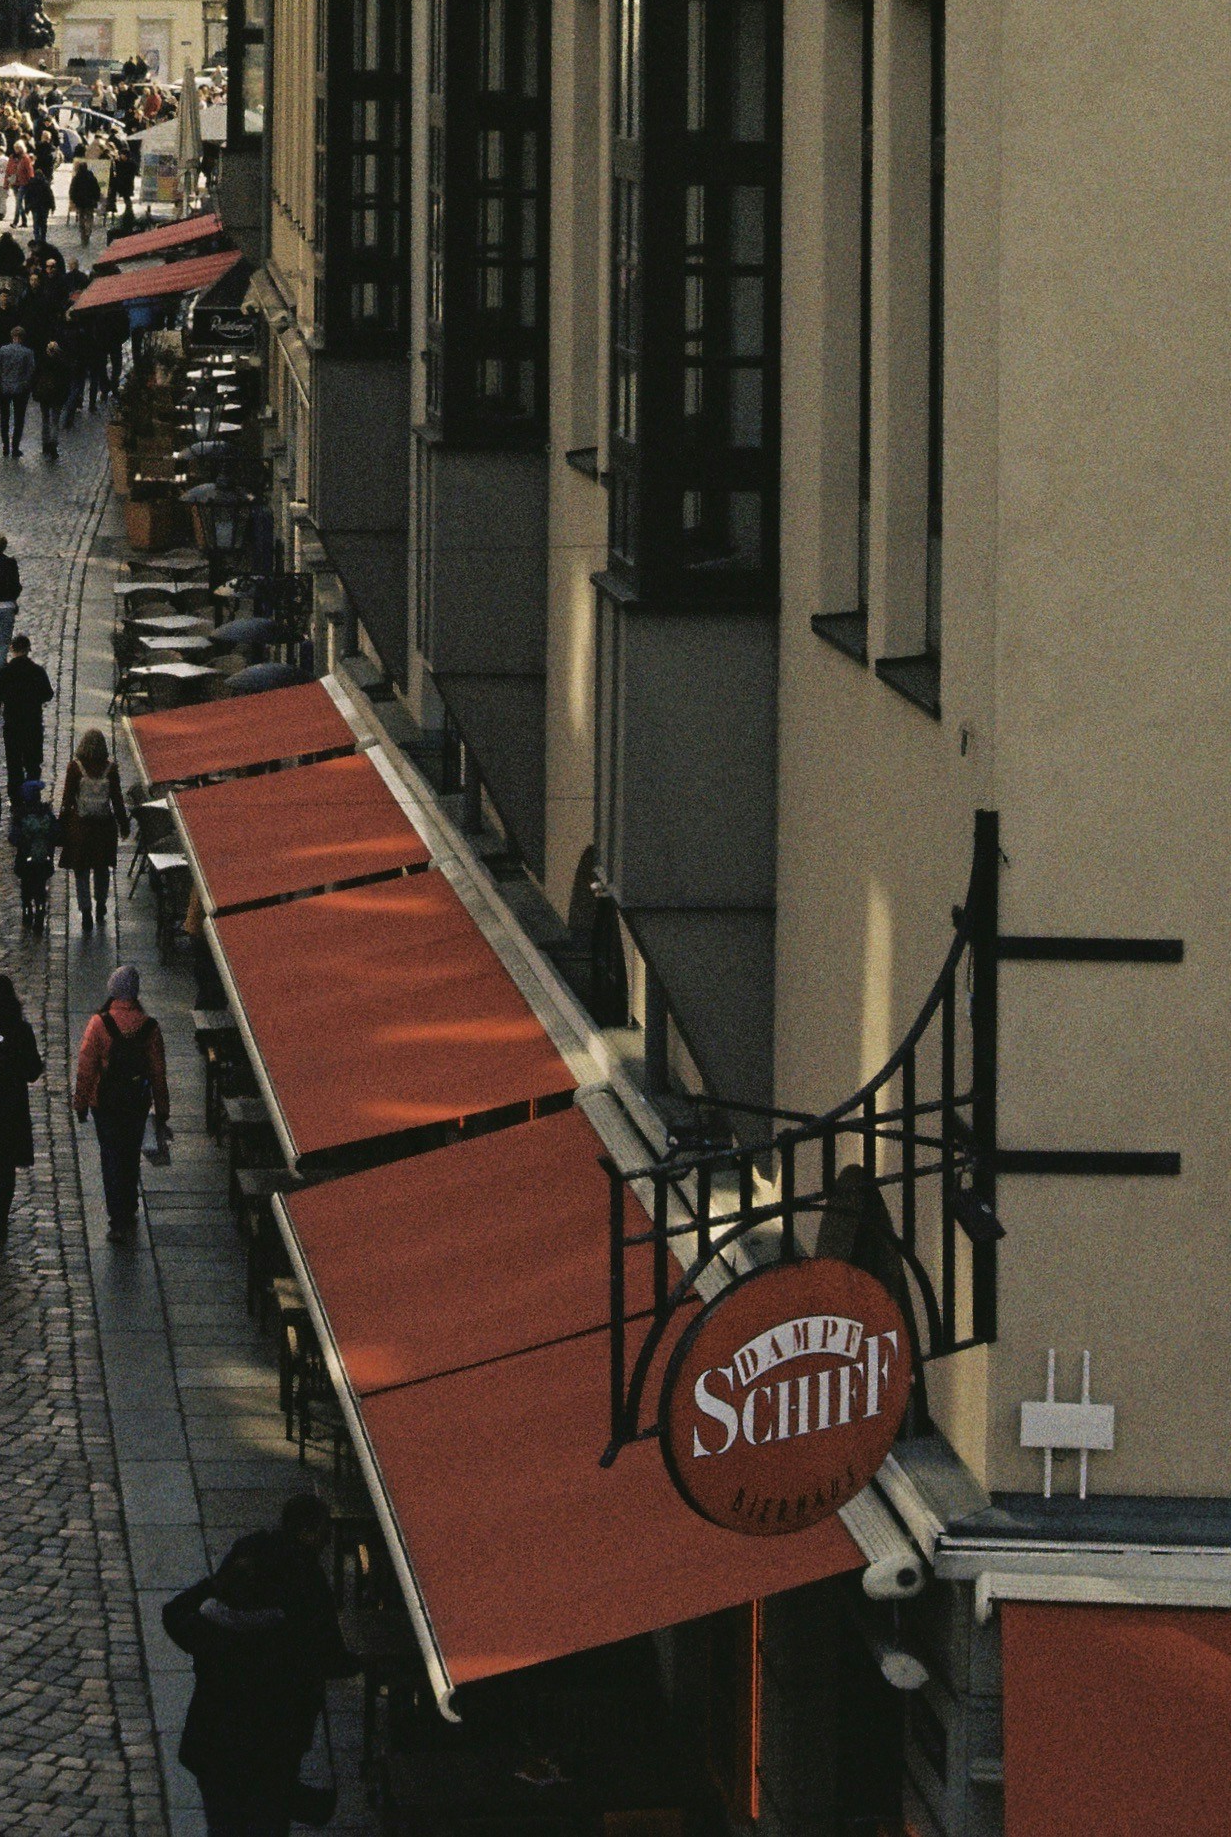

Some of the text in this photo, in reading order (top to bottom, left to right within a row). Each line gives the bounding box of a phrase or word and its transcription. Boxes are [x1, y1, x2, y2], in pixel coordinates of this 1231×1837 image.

[737, 1318, 861, 1383] DAMPF
[693, 1330, 898, 1458] SCHIFF
[732, 1464, 856, 1524] BIERHAUS
